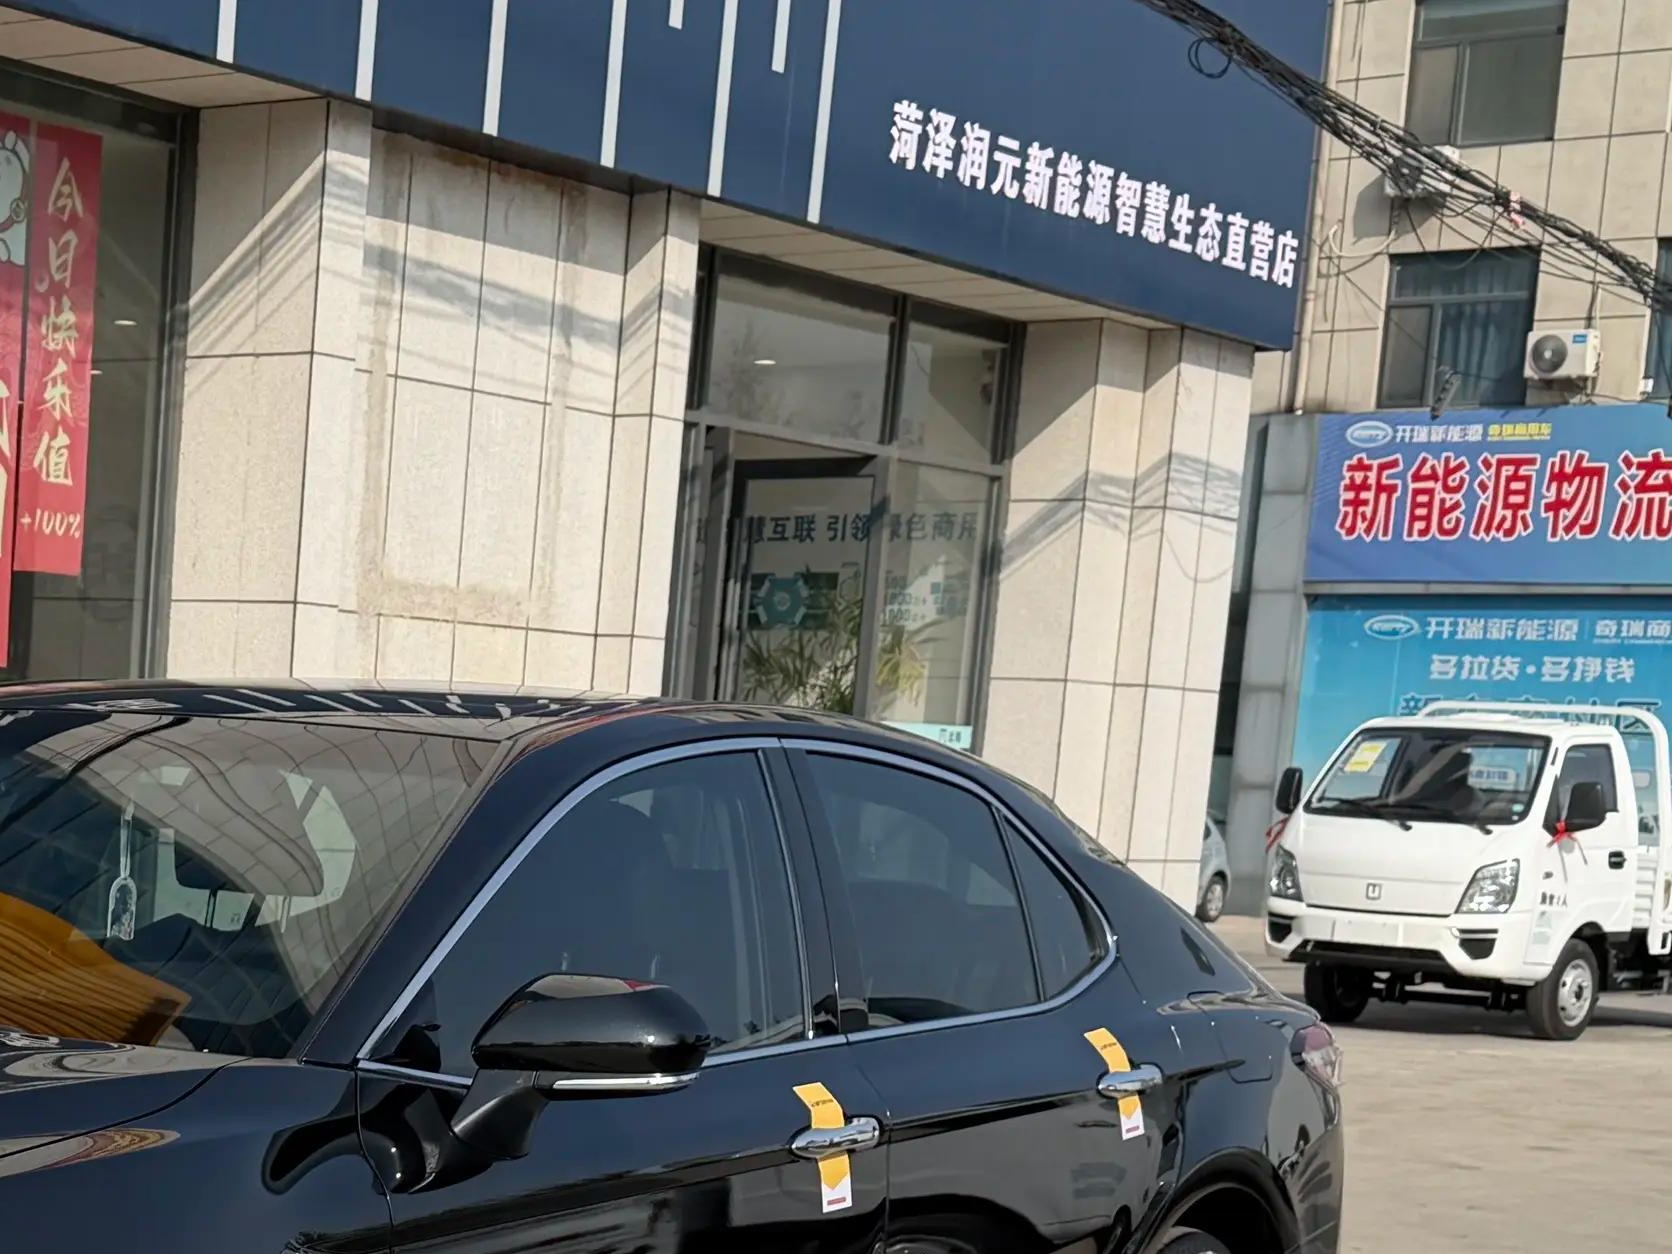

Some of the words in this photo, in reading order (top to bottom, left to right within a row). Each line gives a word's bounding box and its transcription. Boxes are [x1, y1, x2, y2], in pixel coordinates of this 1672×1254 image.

[889, 99, 1299, 288] 菏泽润元新能源智慧生态直营店
[33, 157, 84, 486] 今日快乐值
[1335, 449, 1672, 543] 新能源物流
[1427, 616, 1579, 641] 开瑞新能源
